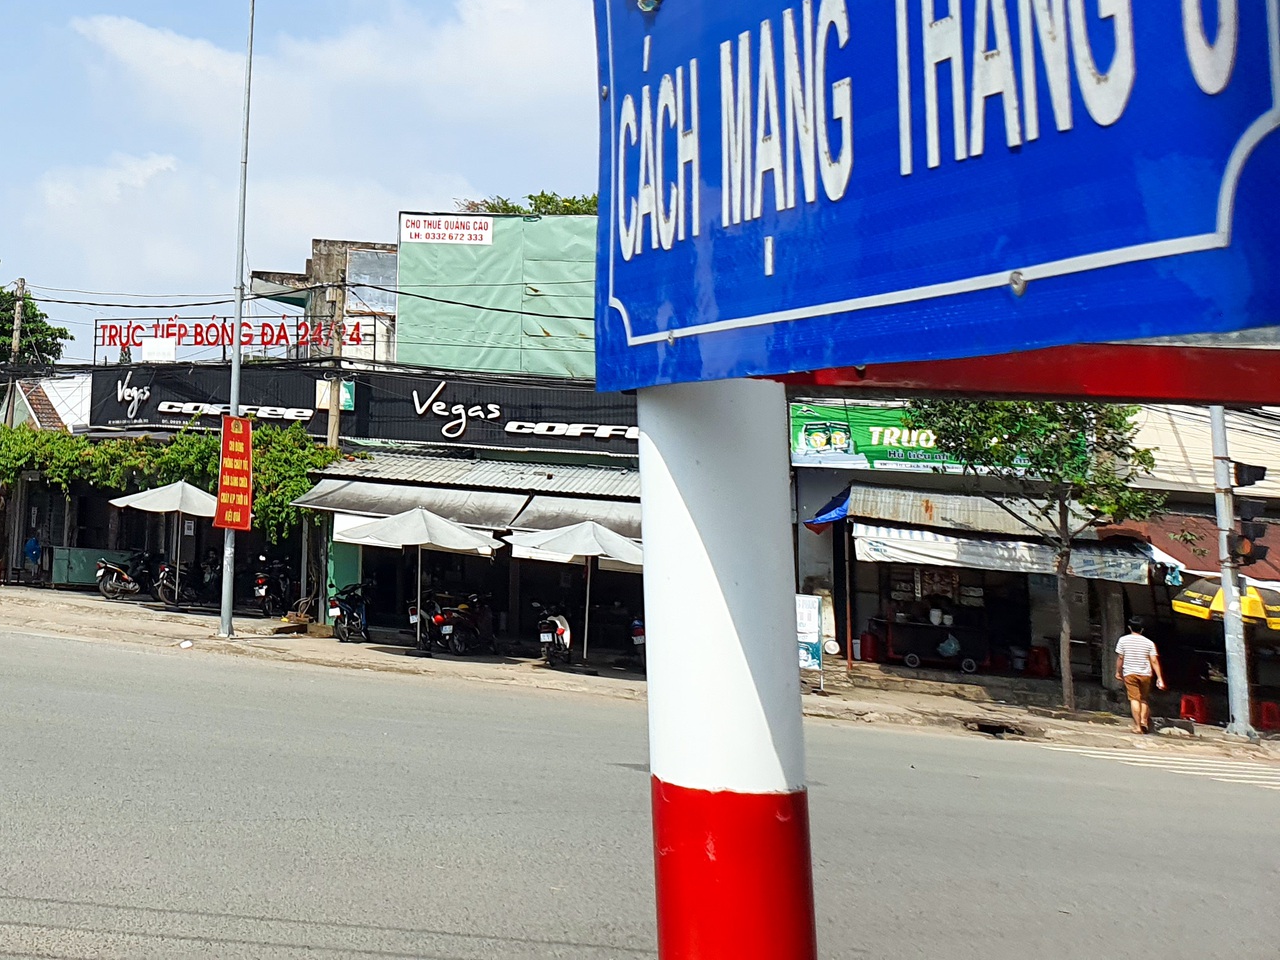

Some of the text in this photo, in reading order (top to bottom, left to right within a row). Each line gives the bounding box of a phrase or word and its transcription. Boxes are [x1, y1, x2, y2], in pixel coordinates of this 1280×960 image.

[618, 36, 700, 262] CÁCH
[405, 219, 421, 229] CHO
[444, 218, 471, 231] QUẢNG
[472, 219, 489, 231] CÁO
[409, 232, 484, 242] LH: 0332 672 333
[100, 321, 146, 351] TRỰC
[260, 314, 291, 346] ĐÁ
[117, 370, 151, 419] Vegas
[412, 381, 501, 438] Vegas
[888, 449, 904, 459] Hủ
[907, 449, 931, 460] tiếu
